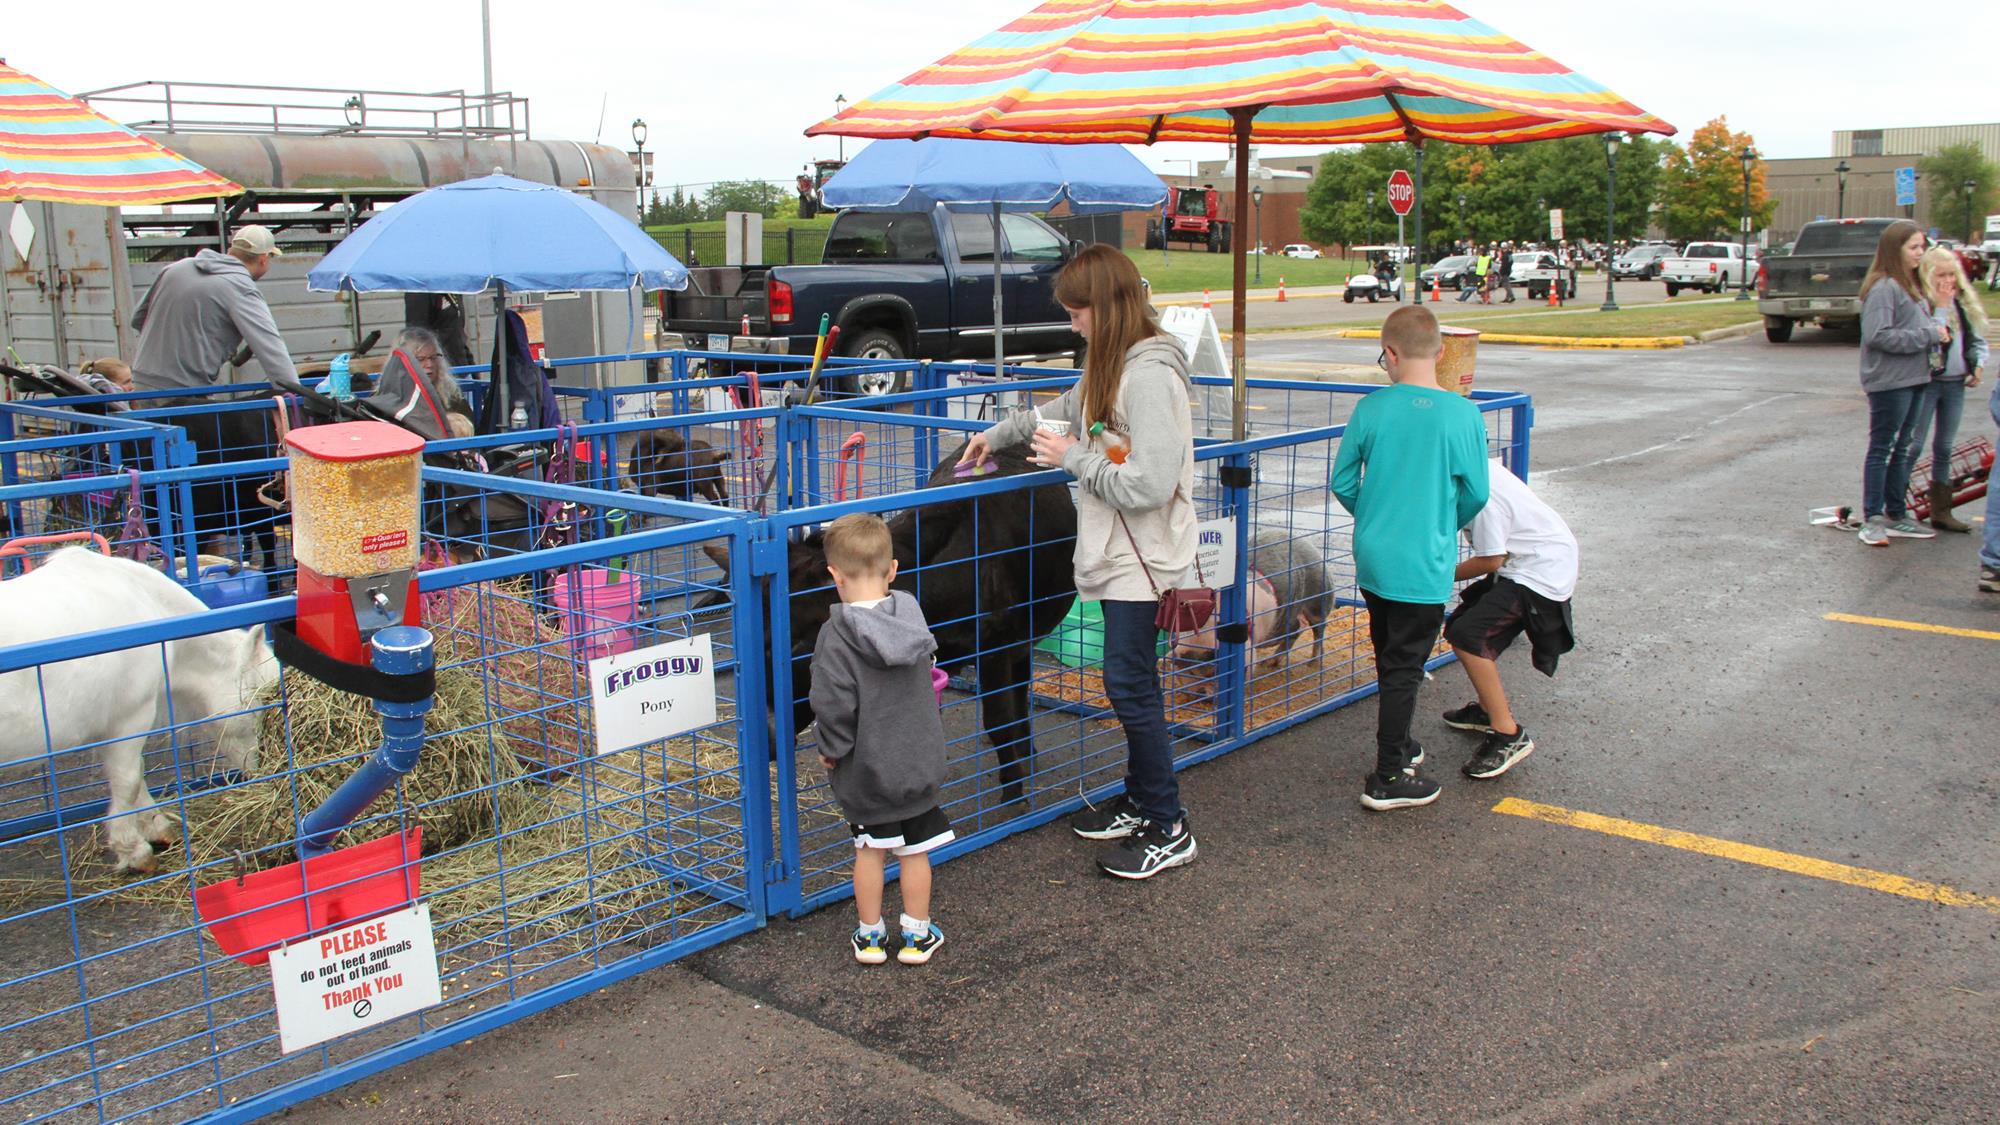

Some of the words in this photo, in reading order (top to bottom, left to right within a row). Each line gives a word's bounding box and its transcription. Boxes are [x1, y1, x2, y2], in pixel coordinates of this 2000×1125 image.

[1390, 184, 1411, 201] STOP
[363, 543, 378, 551] only
[379, 539, 401, 549] please
[377, 532, 406, 542] Quarters
[1199, 530, 1222, 545] IVER
[1199, 548, 1219, 558] merican
[605, 656, 702, 696] Froggy
[640, 699, 674, 715] Pony
[320, 921, 388, 960] PLEASE
[300, 969, 315, 983] do
[319, 962, 338, 978] not
[341, 952, 366, 970] feed
[370, 939, 412, 961] animals
[326, 973, 345, 988] out
[349, 968, 360, 981] of
[362, 958, 391, 977] hand.
[322, 981, 373, 1011] Thank
[374, 973, 403, 994] You
